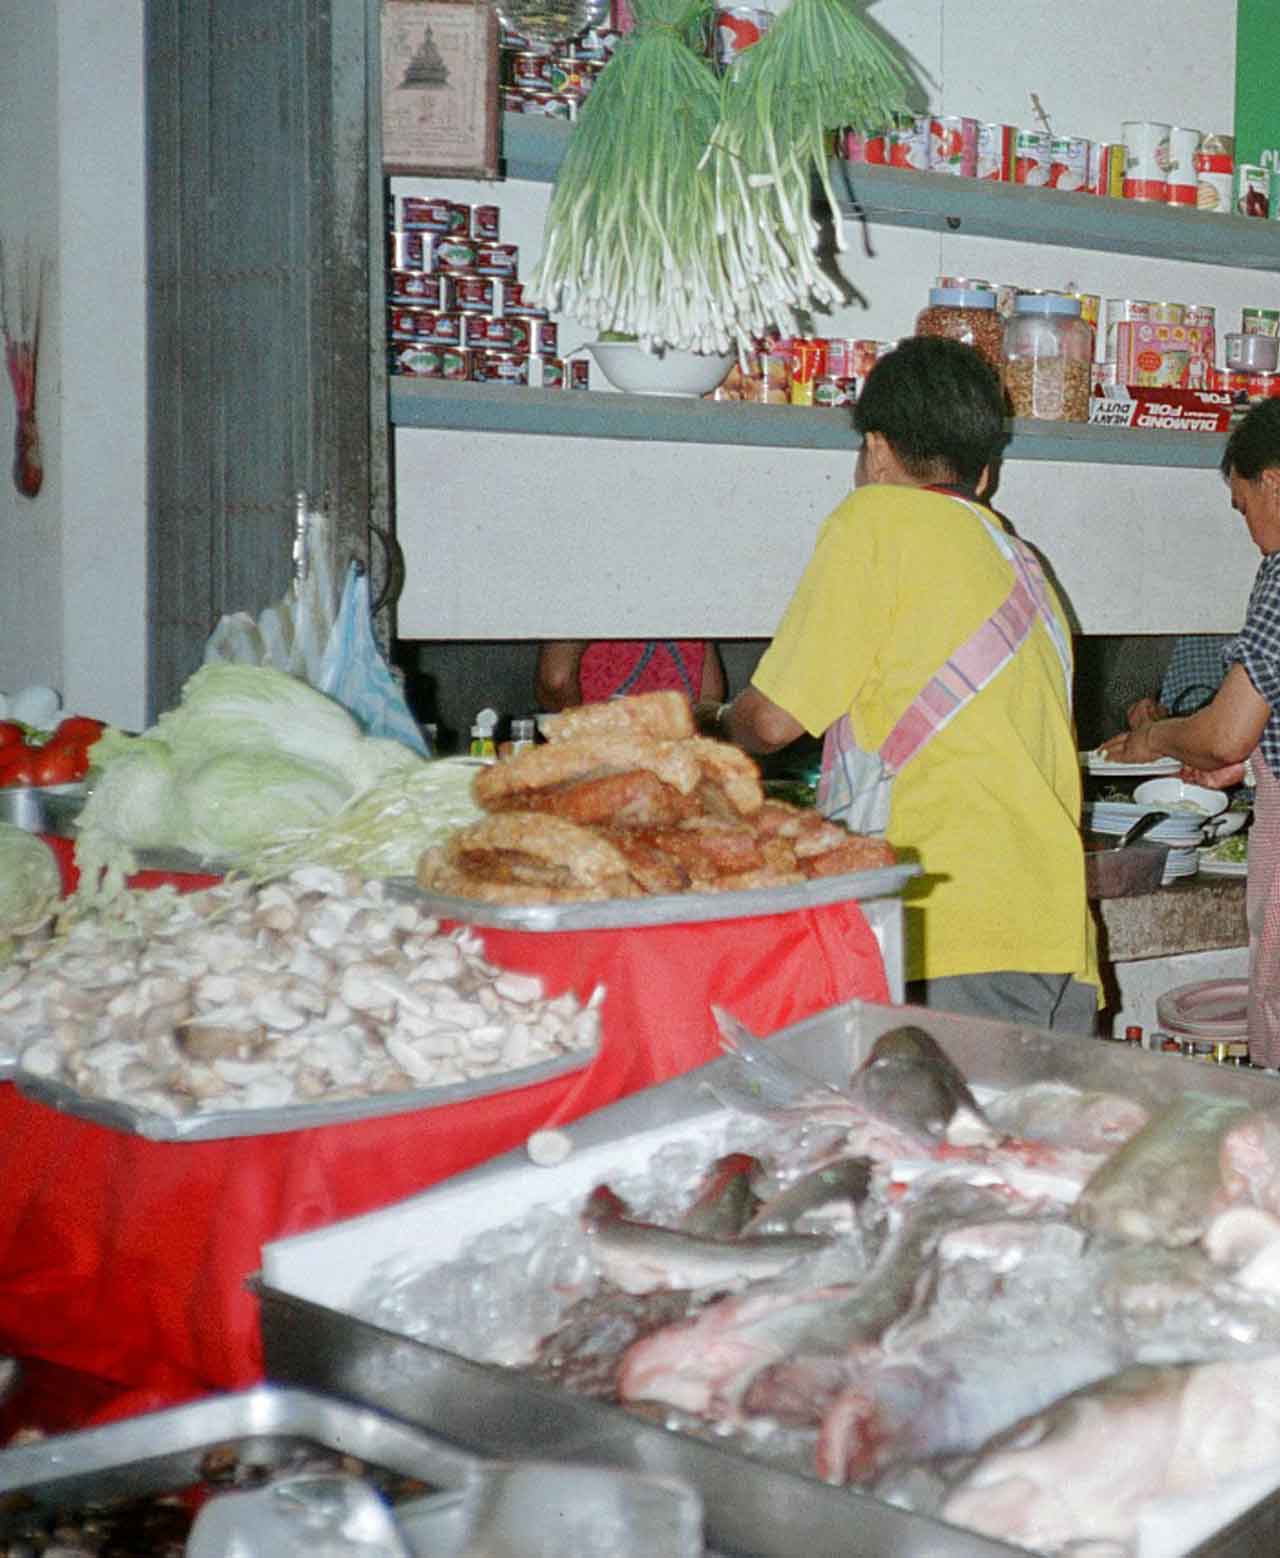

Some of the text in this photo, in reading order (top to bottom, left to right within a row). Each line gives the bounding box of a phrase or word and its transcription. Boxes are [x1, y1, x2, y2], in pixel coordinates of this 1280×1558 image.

[1097, 403, 1131, 414] DUTY
[1145, 403, 1183, 416] FOIL
[1091, 415, 1130, 426] HEAVY
[1137, 415, 1218, 431] DIAMOND
